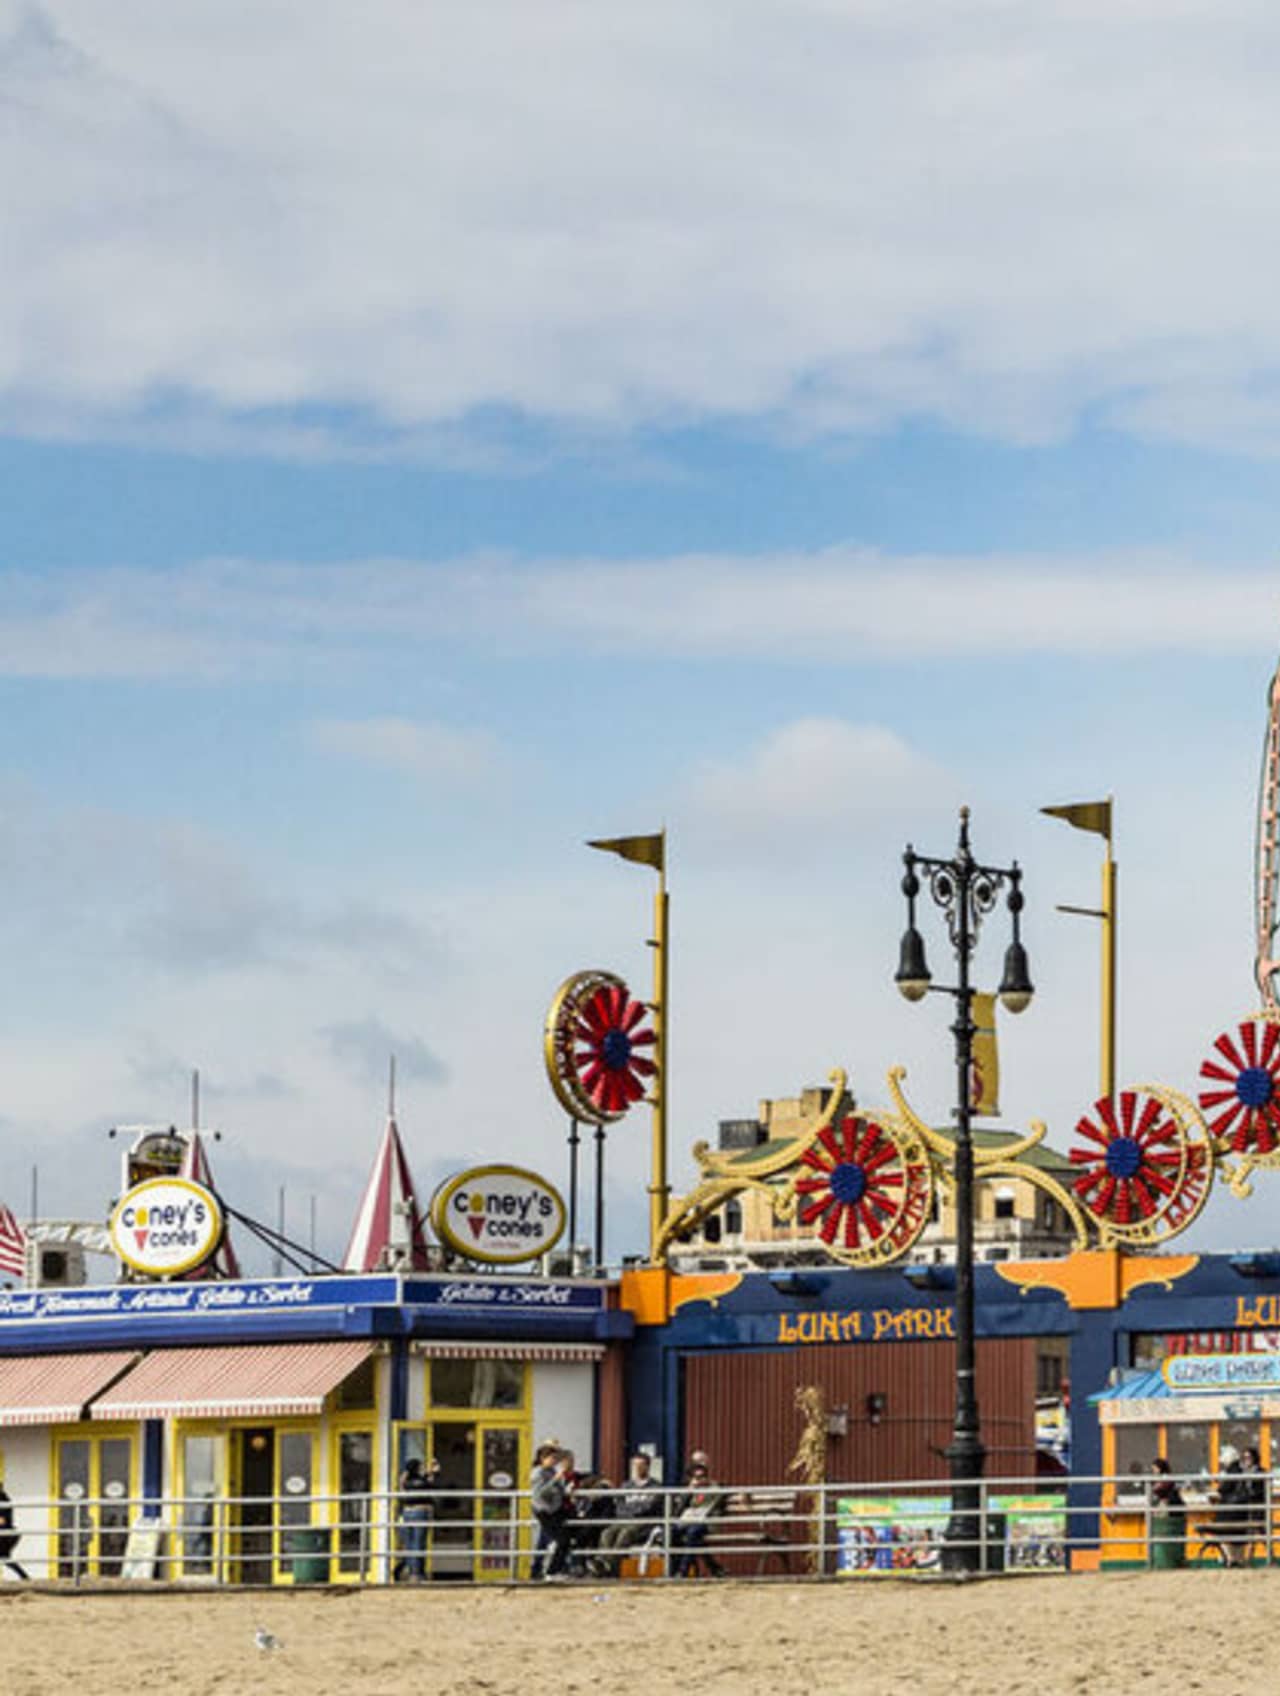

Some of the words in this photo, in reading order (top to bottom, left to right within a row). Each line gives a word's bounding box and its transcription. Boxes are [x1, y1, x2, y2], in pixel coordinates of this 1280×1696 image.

[779, 1311, 861, 1342] LUNA
[874, 1309, 953, 1338] PARK
[1174, 1361, 1221, 1381] LUNA
[1226, 1360, 1276, 1380] PARK
